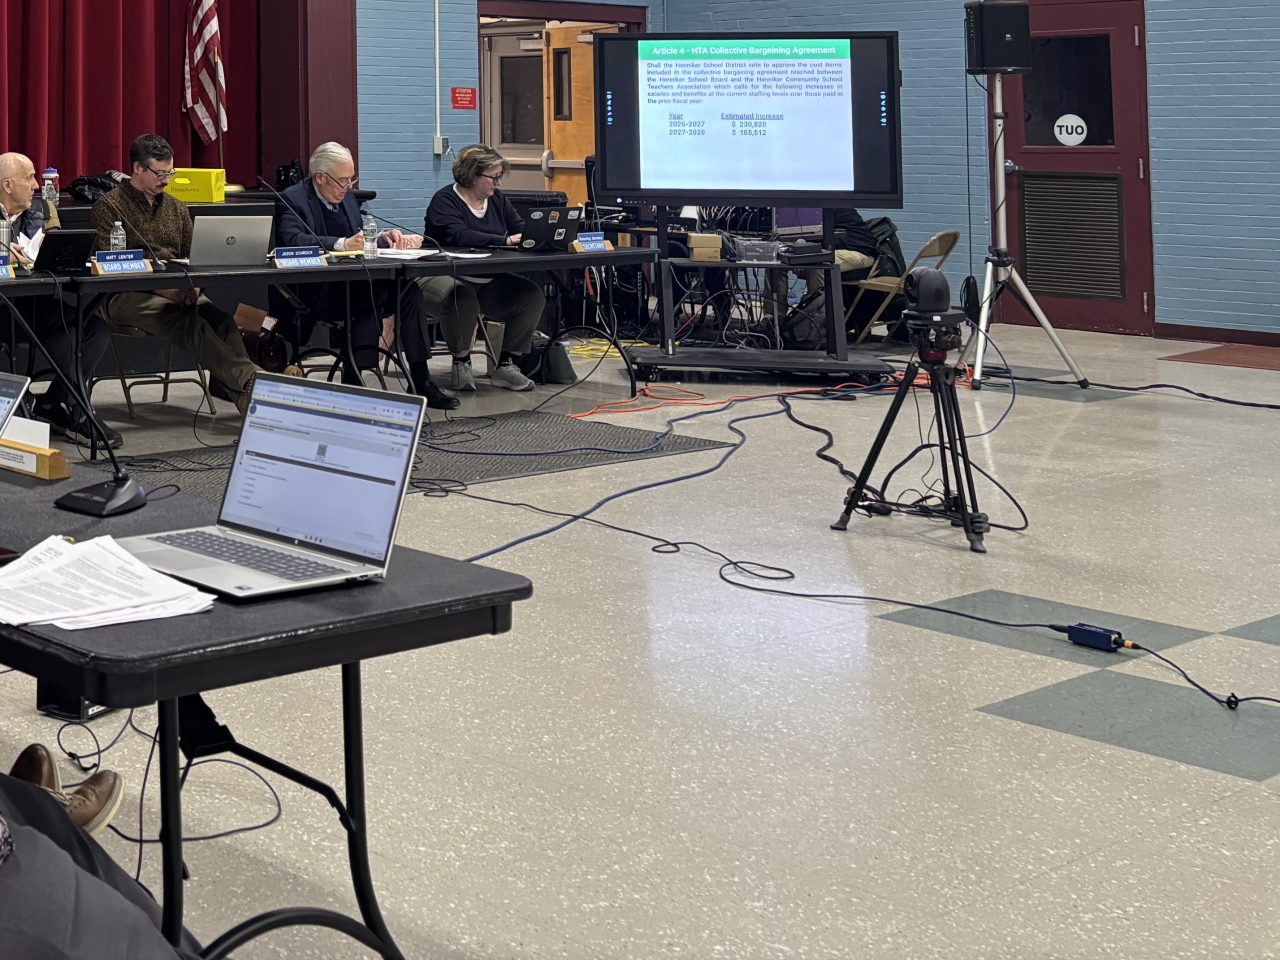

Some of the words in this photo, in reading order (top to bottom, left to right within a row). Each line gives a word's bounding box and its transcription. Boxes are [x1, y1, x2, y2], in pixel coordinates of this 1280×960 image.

[749, 47, 791, 55] Bargaining
[792, 47, 836, 55] Agreement
[102, 262, 122, 271] BOARD
[122, 260, 146, 270] MEMBER
